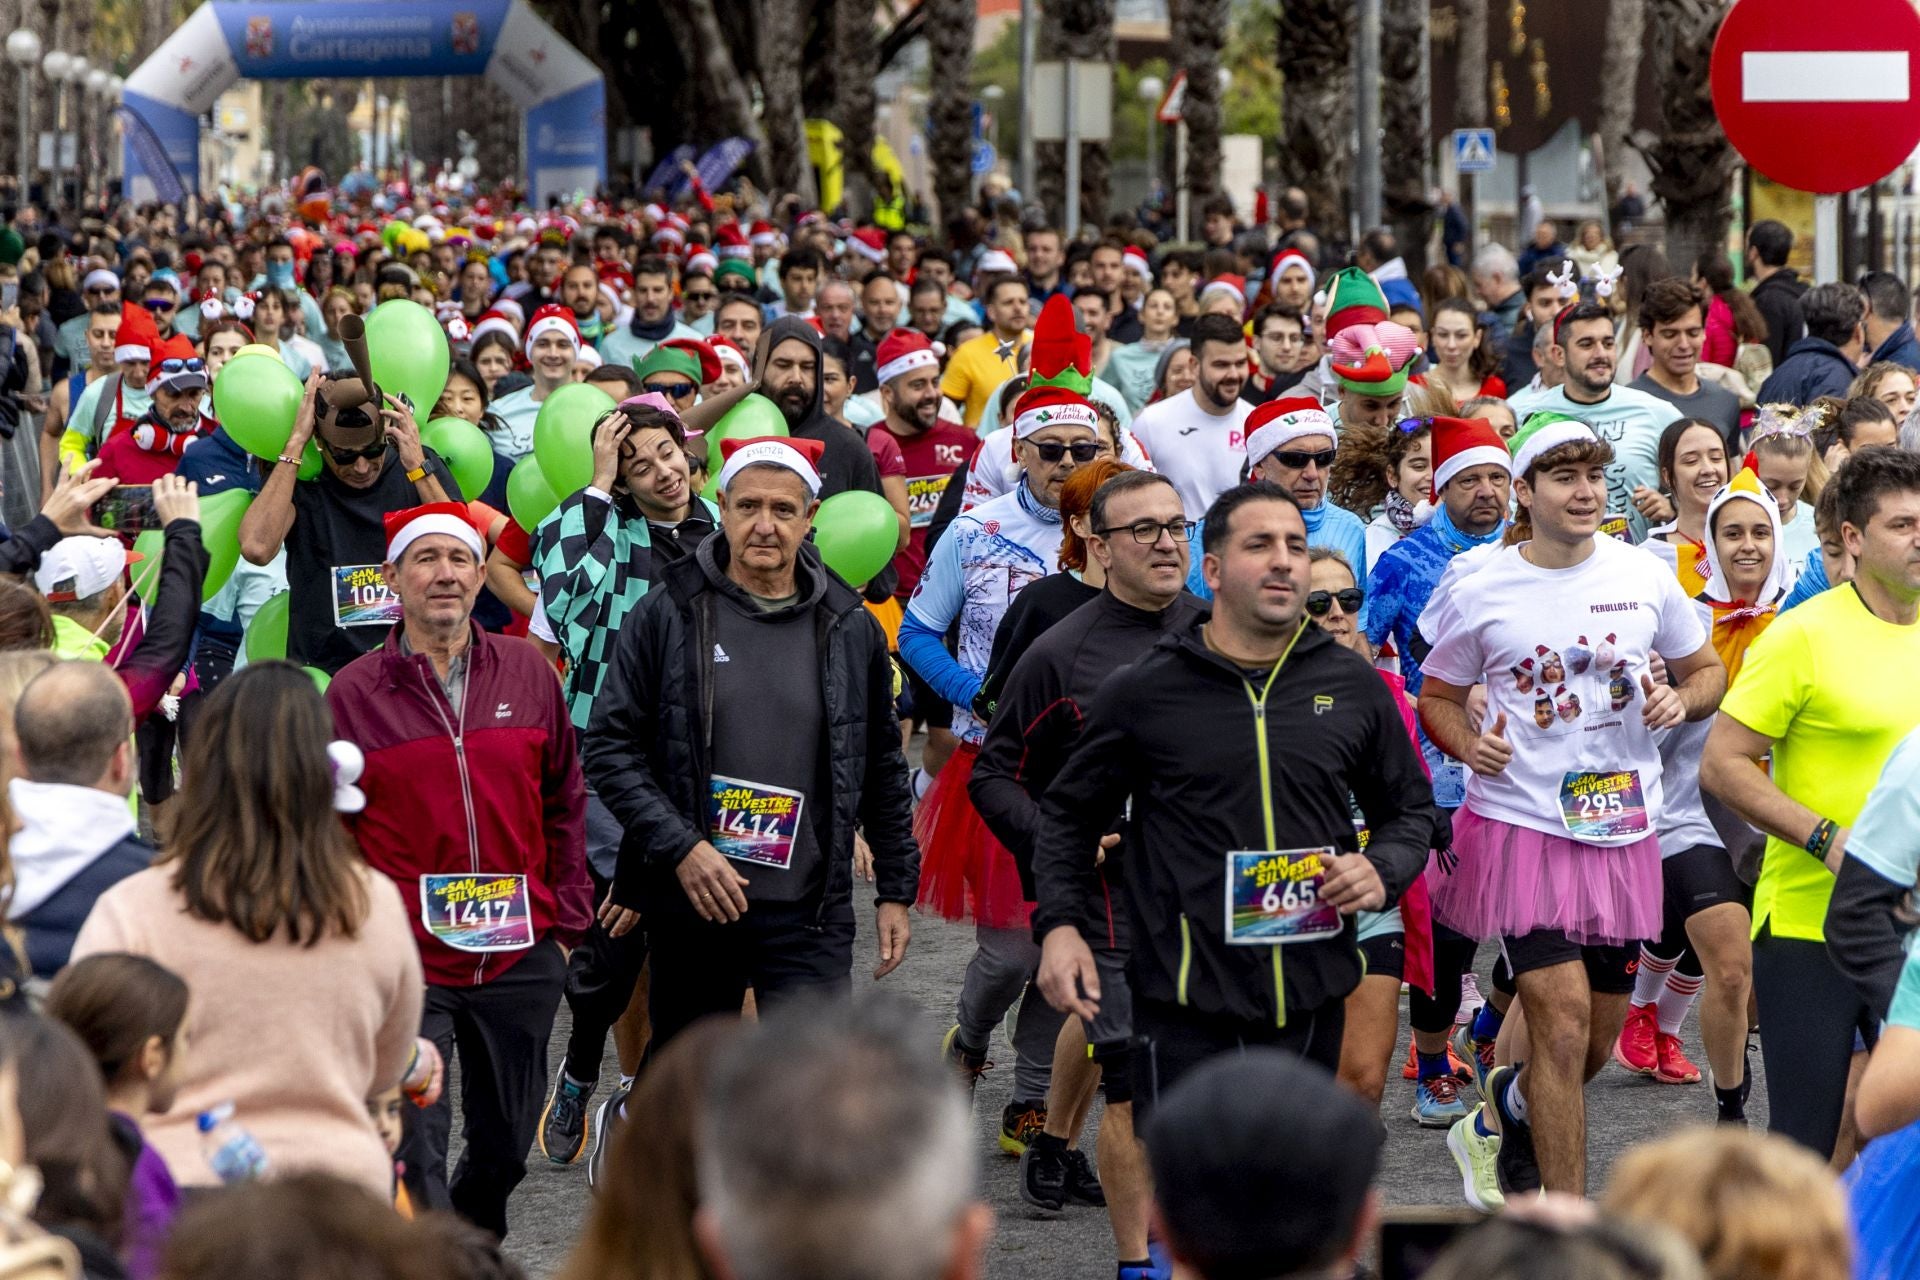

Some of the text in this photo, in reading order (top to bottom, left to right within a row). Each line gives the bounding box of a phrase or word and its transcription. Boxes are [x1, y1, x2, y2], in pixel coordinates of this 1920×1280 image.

[291, 15, 432, 34] Ayuntamiento
[289, 35, 432, 61] Cartagena
[1053, 411, 1088, 421] Navidad
[747, 447, 783, 457] ESSENZA
[352, 568, 374, 579] SAN
[352, 574, 382, 587] SILVE
[1590, 601, 1638, 613] PERULLOS FC
[1573, 773, 1631, 797] SILVESTRE
[1577, 774, 1597, 786] SAN
[724, 789, 753, 799] SAN
[722, 797, 793, 810] SILVESTRE
[1579, 793, 1623, 818] 295
[717, 808, 779, 841] 1414
[1256, 854, 1321, 887] SILVESTR
[1257, 855, 1288, 873] SAN
[448, 878, 476, 893] SAN
[448, 878, 516, 903] SILVESTRE
[1262, 880, 1315, 912] 665
[445, 901, 510, 927] 1417
